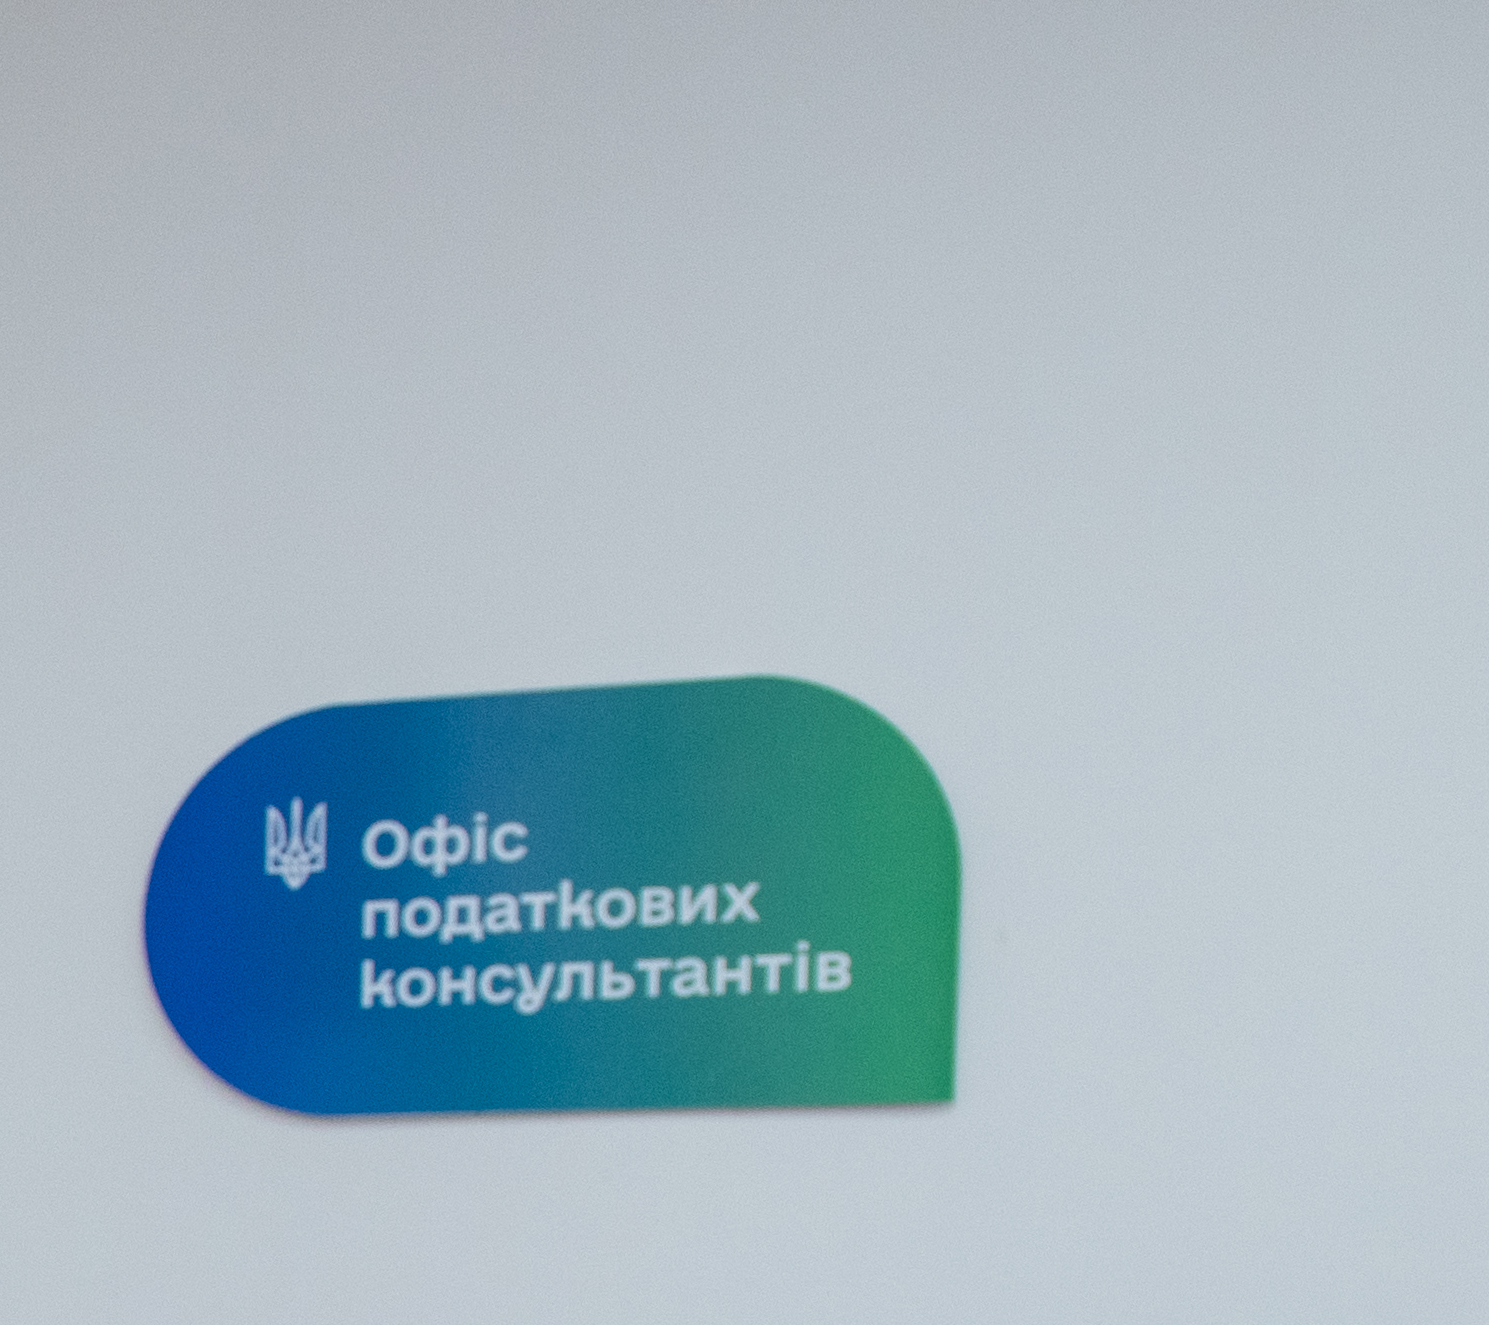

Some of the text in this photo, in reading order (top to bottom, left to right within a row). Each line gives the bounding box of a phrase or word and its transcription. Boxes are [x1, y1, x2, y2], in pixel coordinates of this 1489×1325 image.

[362, 811, 528, 877] Офіс
[361, 878, 760, 944] податкових
[361, 940, 853, 1015] консультантів
